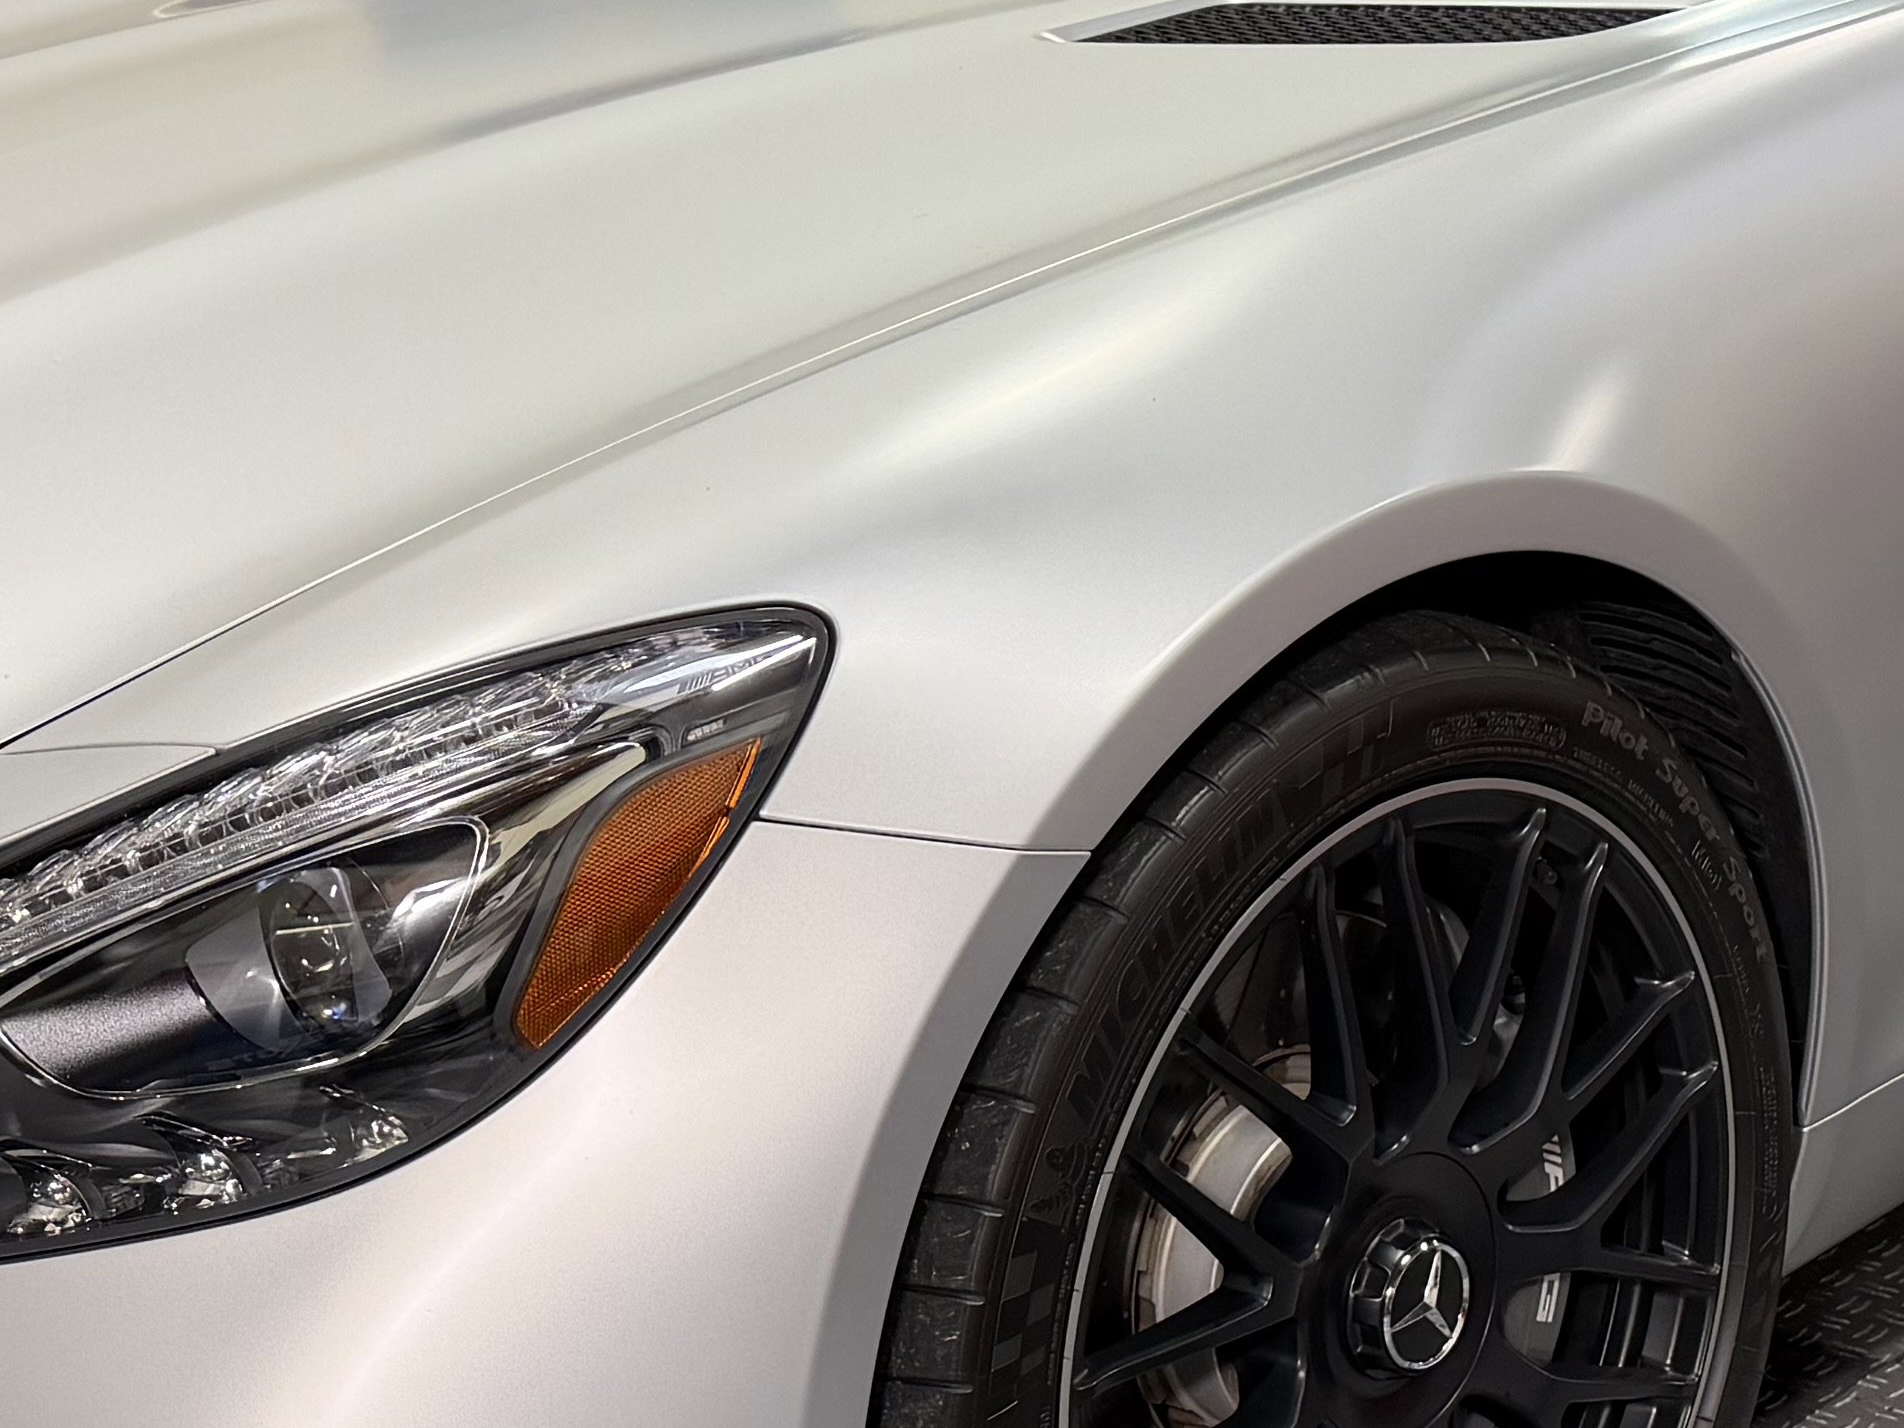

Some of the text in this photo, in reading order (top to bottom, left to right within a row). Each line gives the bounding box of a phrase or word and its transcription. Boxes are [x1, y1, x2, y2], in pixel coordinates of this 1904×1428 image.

[1580, 700, 1649, 760] Pilot
[1655, 757, 1721, 842] Super
[1722, 855, 1771, 964] Sport
